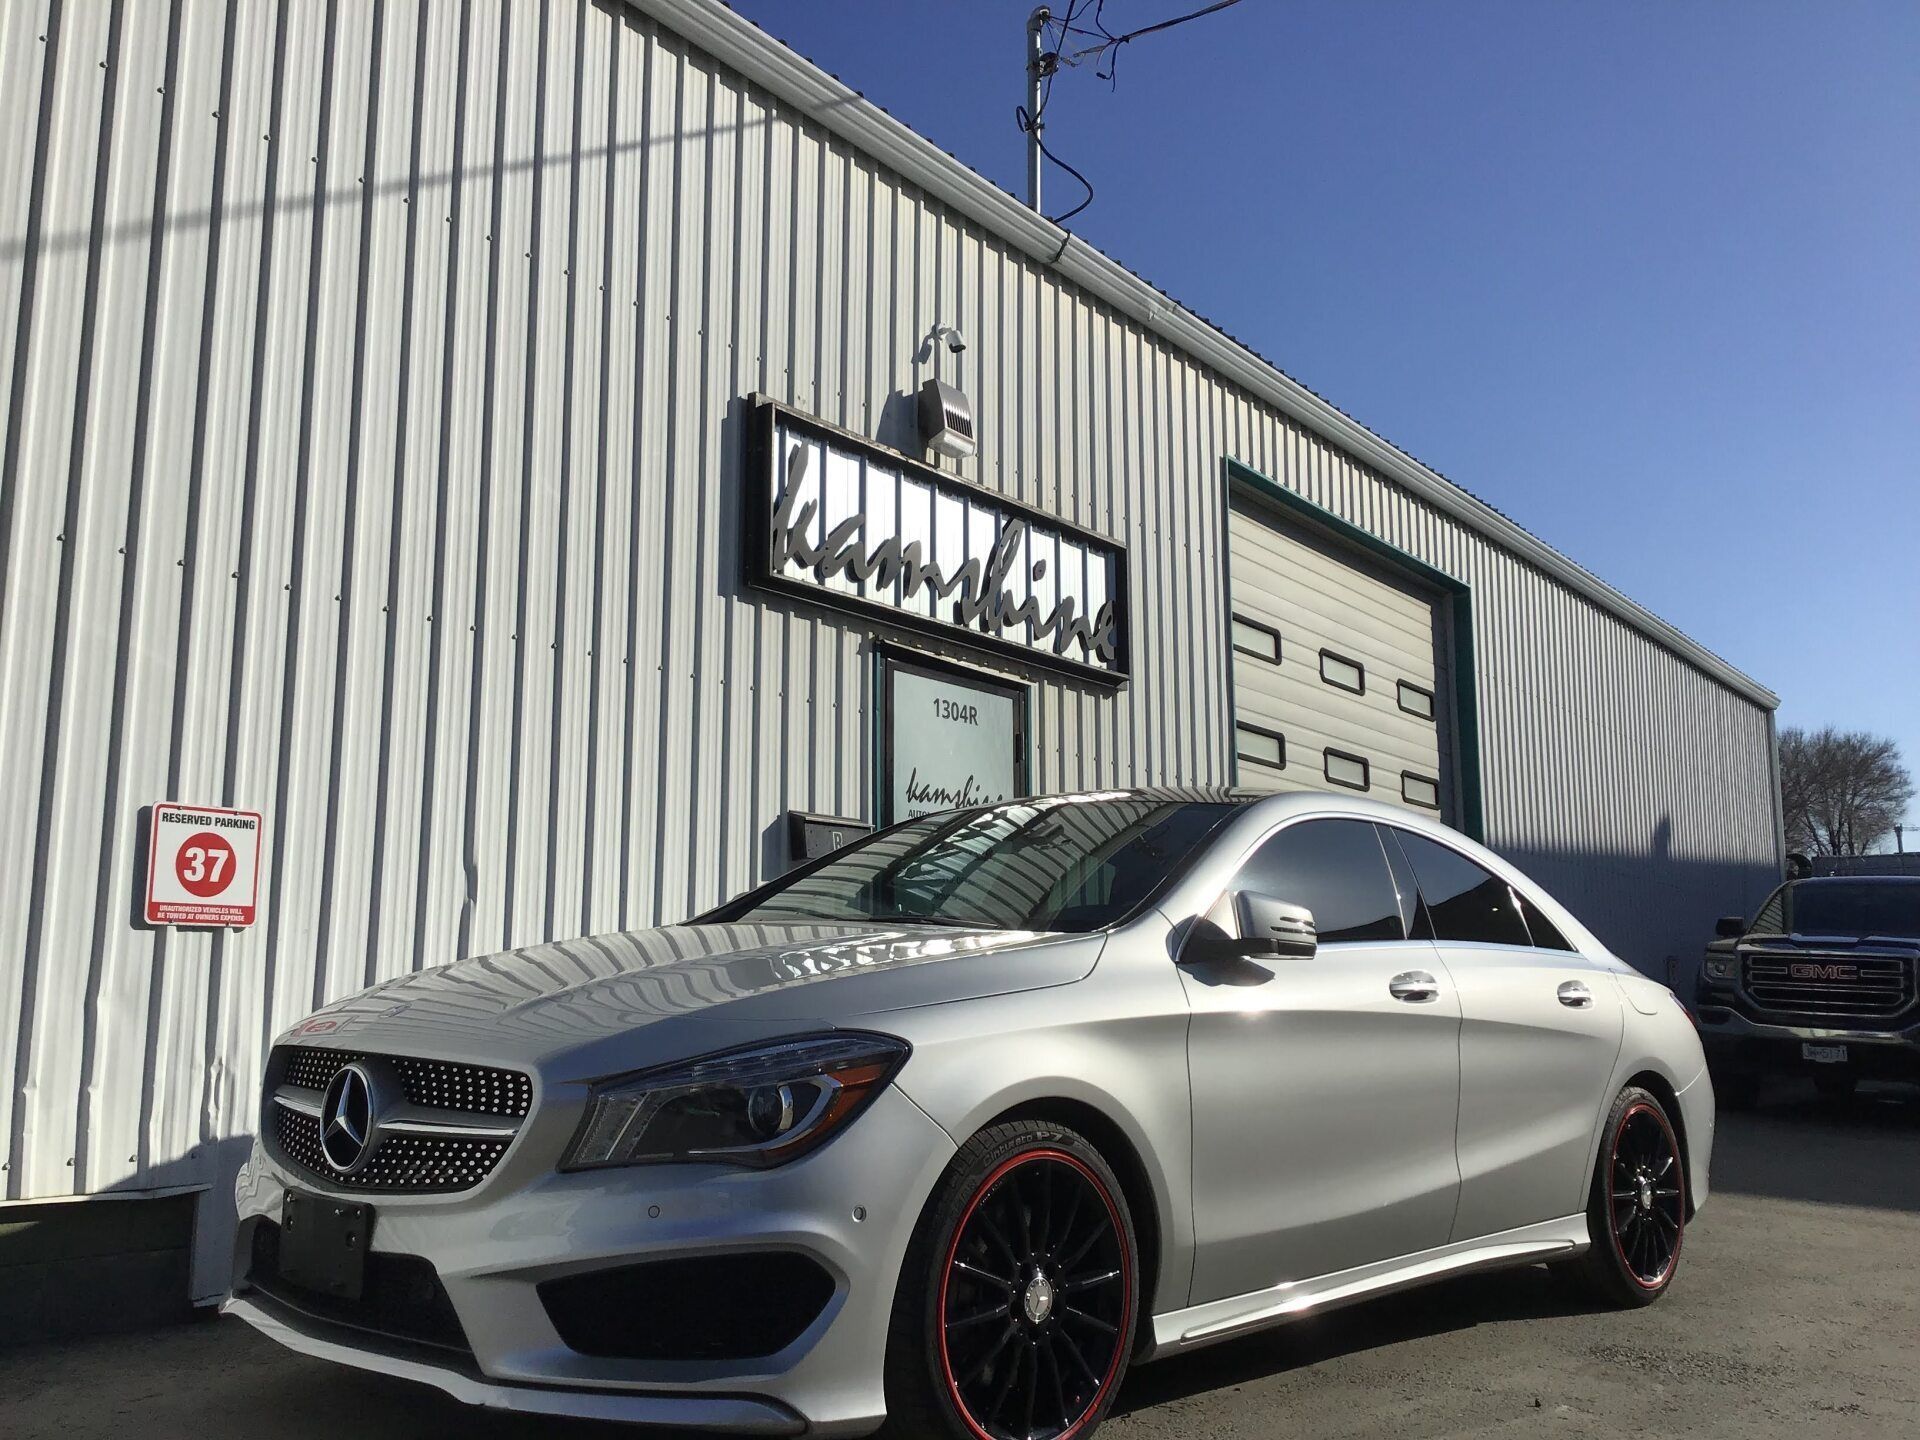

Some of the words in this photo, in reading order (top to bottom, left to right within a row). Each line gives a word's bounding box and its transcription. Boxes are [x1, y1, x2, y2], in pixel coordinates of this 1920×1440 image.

[773, 439, 1115, 662] kamshine
[933, 698, 979, 726] 1304R
[162, 812, 212, 826] RESERVED
[214, 817, 256, 830] PARKING
[183, 847, 229, 883] 37
[159, 904, 202, 913] UNAUTHORIZED
[203, 906, 229, 914] VEHICLES
[166, 912, 187, 920] TOWED
[1790, 964, 1858, 980] GMC
